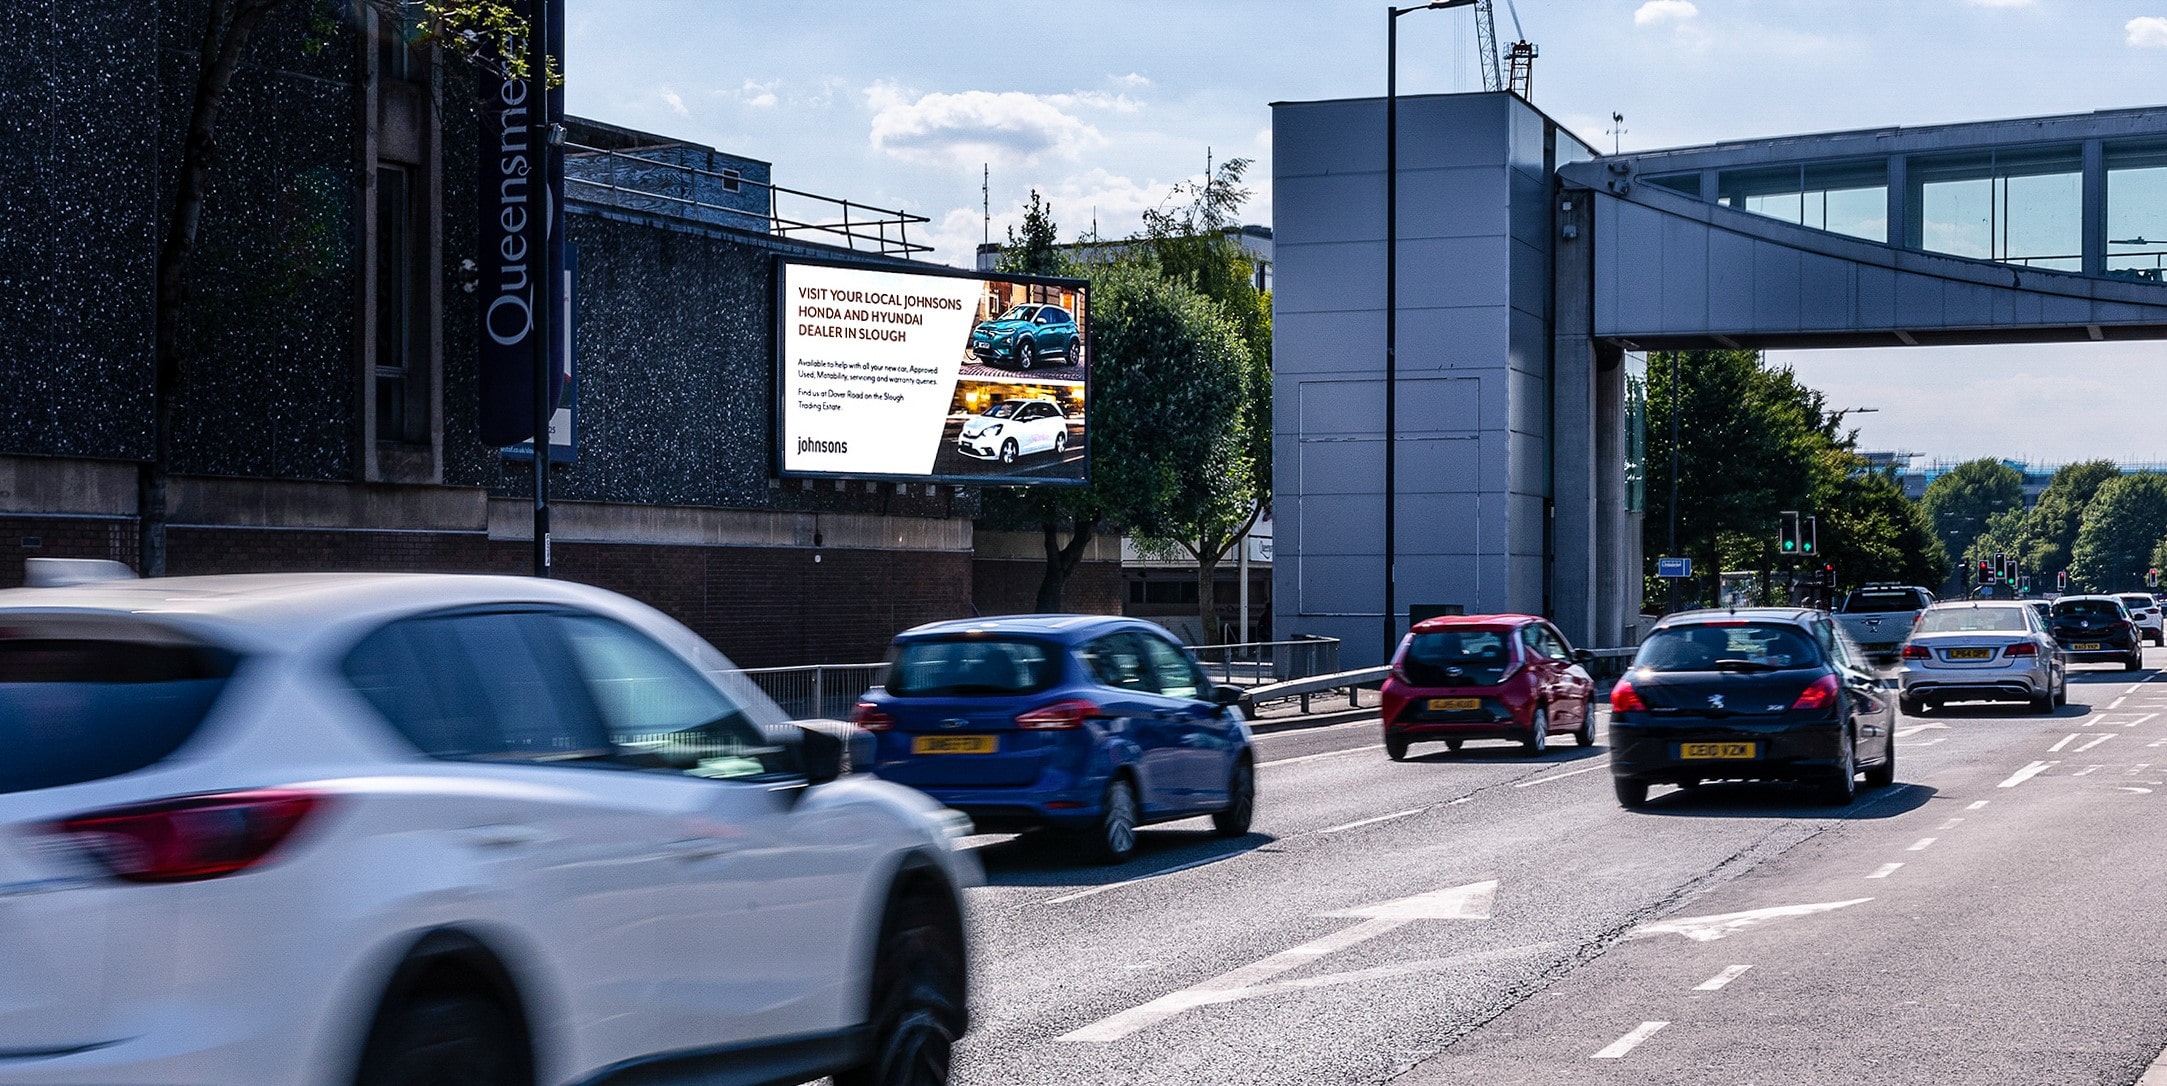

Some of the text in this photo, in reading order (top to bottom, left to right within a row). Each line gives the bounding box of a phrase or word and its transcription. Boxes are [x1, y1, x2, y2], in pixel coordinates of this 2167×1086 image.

[799, 287, 962, 310] VISIT YOUR LOCAL JOHNSONS
[799, 305, 923, 325] HONDA AND HYUNDAI
[799, 324, 906, 342] DEALER IN SLOUGH
[798, 358, 826, 368] Available
[834, 361, 847, 370] help
[862, 362, 870, 370] all
[870, 364, 884, 372] your
[909, 365, 938, 375] Approved
[850, 374, 876, 384] servicing
[876, 374, 888, 383] and
[889, 377, 915, 385] warranty
[798, 388, 812, 396] Find
[828, 389, 846, 398] Dover
[847, 390, 864, 399] Road
[873, 391, 883, 400] the
[883, 392, 905, 403] Slough
[798, 400, 822, 412] Trading
[798, 436, 848, 455] johnsons
